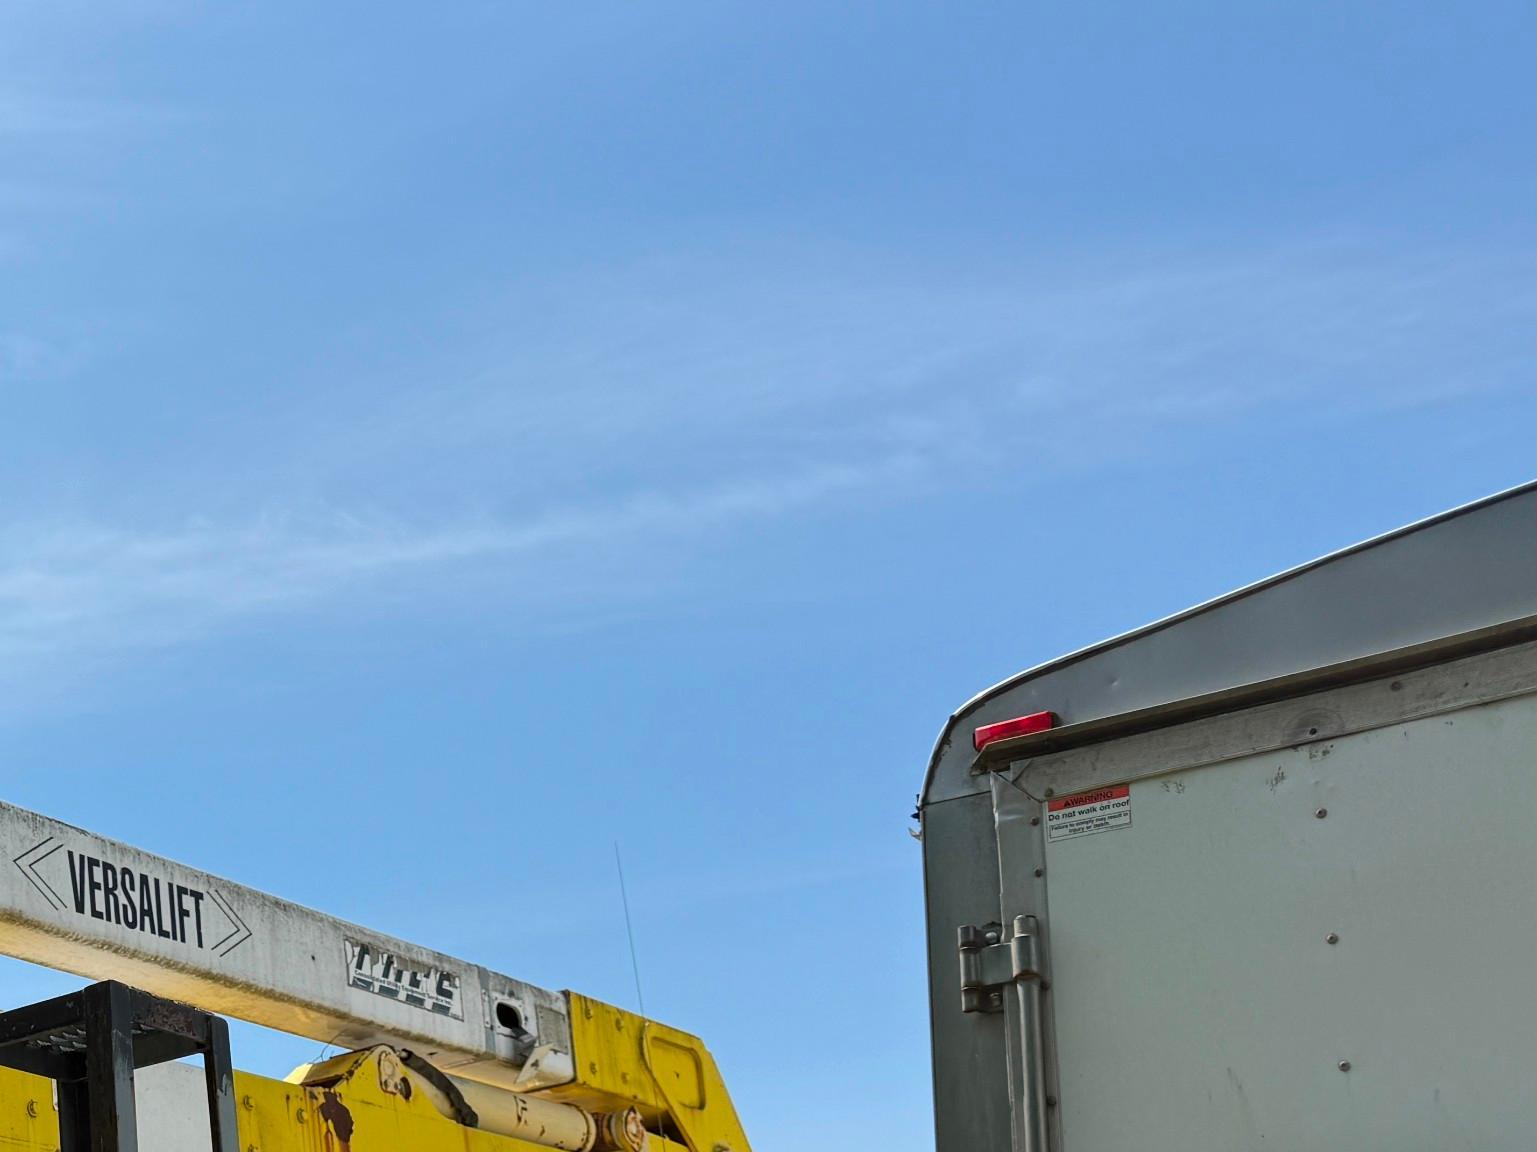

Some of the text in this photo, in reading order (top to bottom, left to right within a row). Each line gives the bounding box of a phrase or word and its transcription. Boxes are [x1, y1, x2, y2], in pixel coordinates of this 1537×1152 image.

[1062, 811, 1076, 819] not
[1078, 805, 1098, 816] walk
[1112, 800, 1129, 809] roof
[66, 849, 204, 949] VERSALIFT
